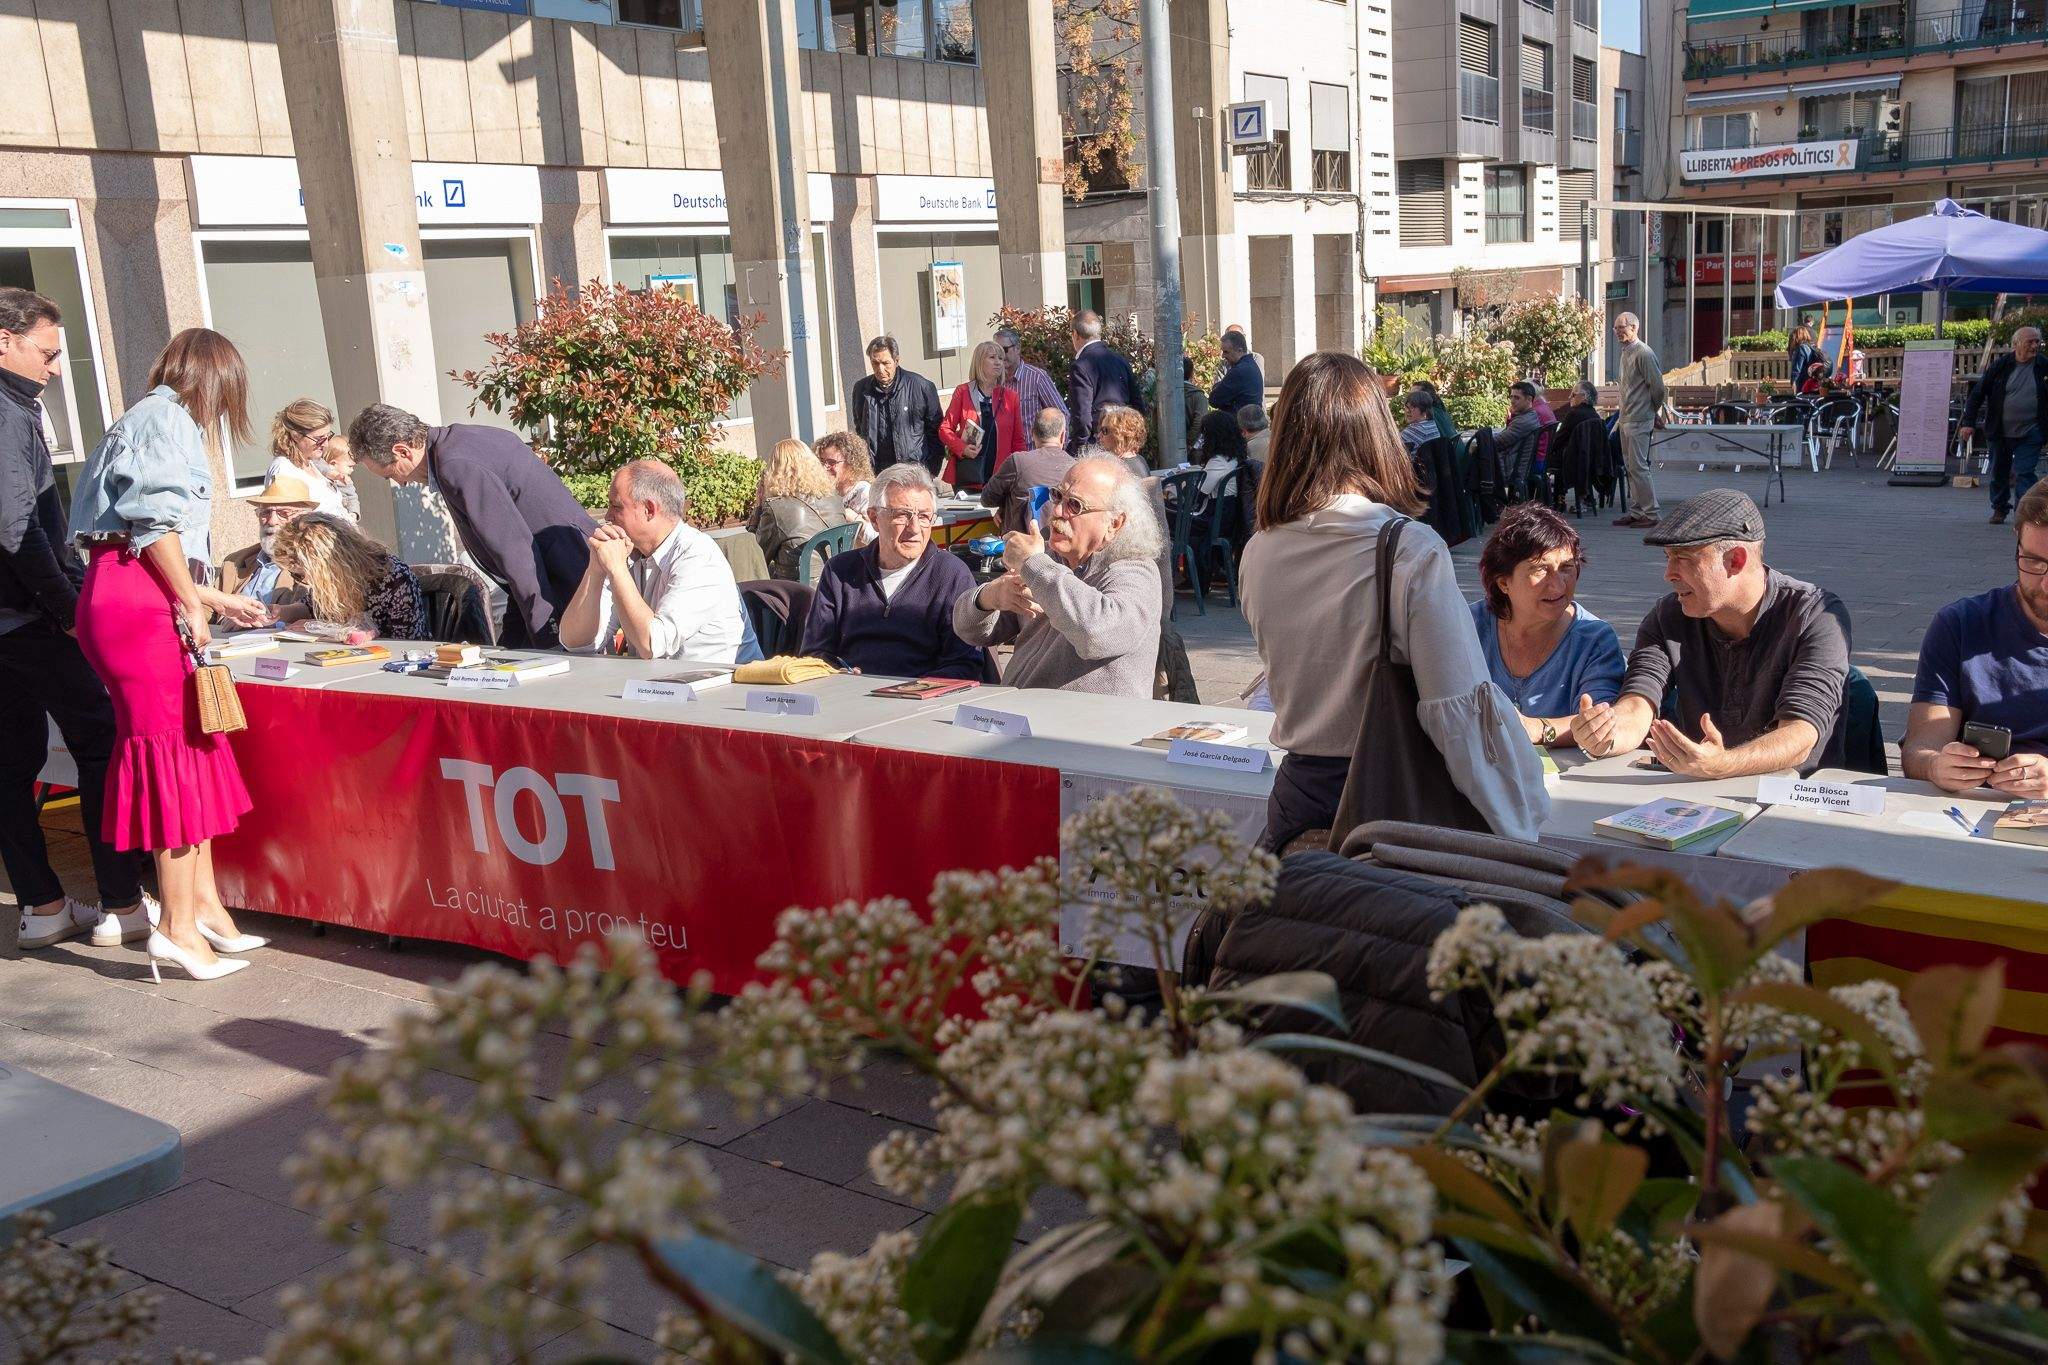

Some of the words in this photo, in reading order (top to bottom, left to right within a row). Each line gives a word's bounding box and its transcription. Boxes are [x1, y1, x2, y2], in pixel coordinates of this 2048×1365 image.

[1686, 157, 1738, 173] LLIBERTAT
[1740, 153, 1780, 170] PRESOS
[1782, 148, 1834, 166] POLÍTICS!
[673, 194, 727, 208] Deutsche
[919, 196, 959, 209] Deutsche
[961, 197, 982, 209] Bank
[1183, 749, 1200, 758] José
[1200, 751, 1222, 761] García
[1222, 754, 1251, 764] Delgado
[1793, 783, 1818, 794] Clara
[1819, 786, 1849, 797] Biosca
[1794, 794, 1821, 804] Josep
[1822, 796, 1850, 806] Vicent
[439, 757, 621, 871] TOT
[426, 878, 461, 909] La
[466, 886, 531, 929] ciutat
[540, 906, 557, 930] a
[639, 912, 687, 949] teu
